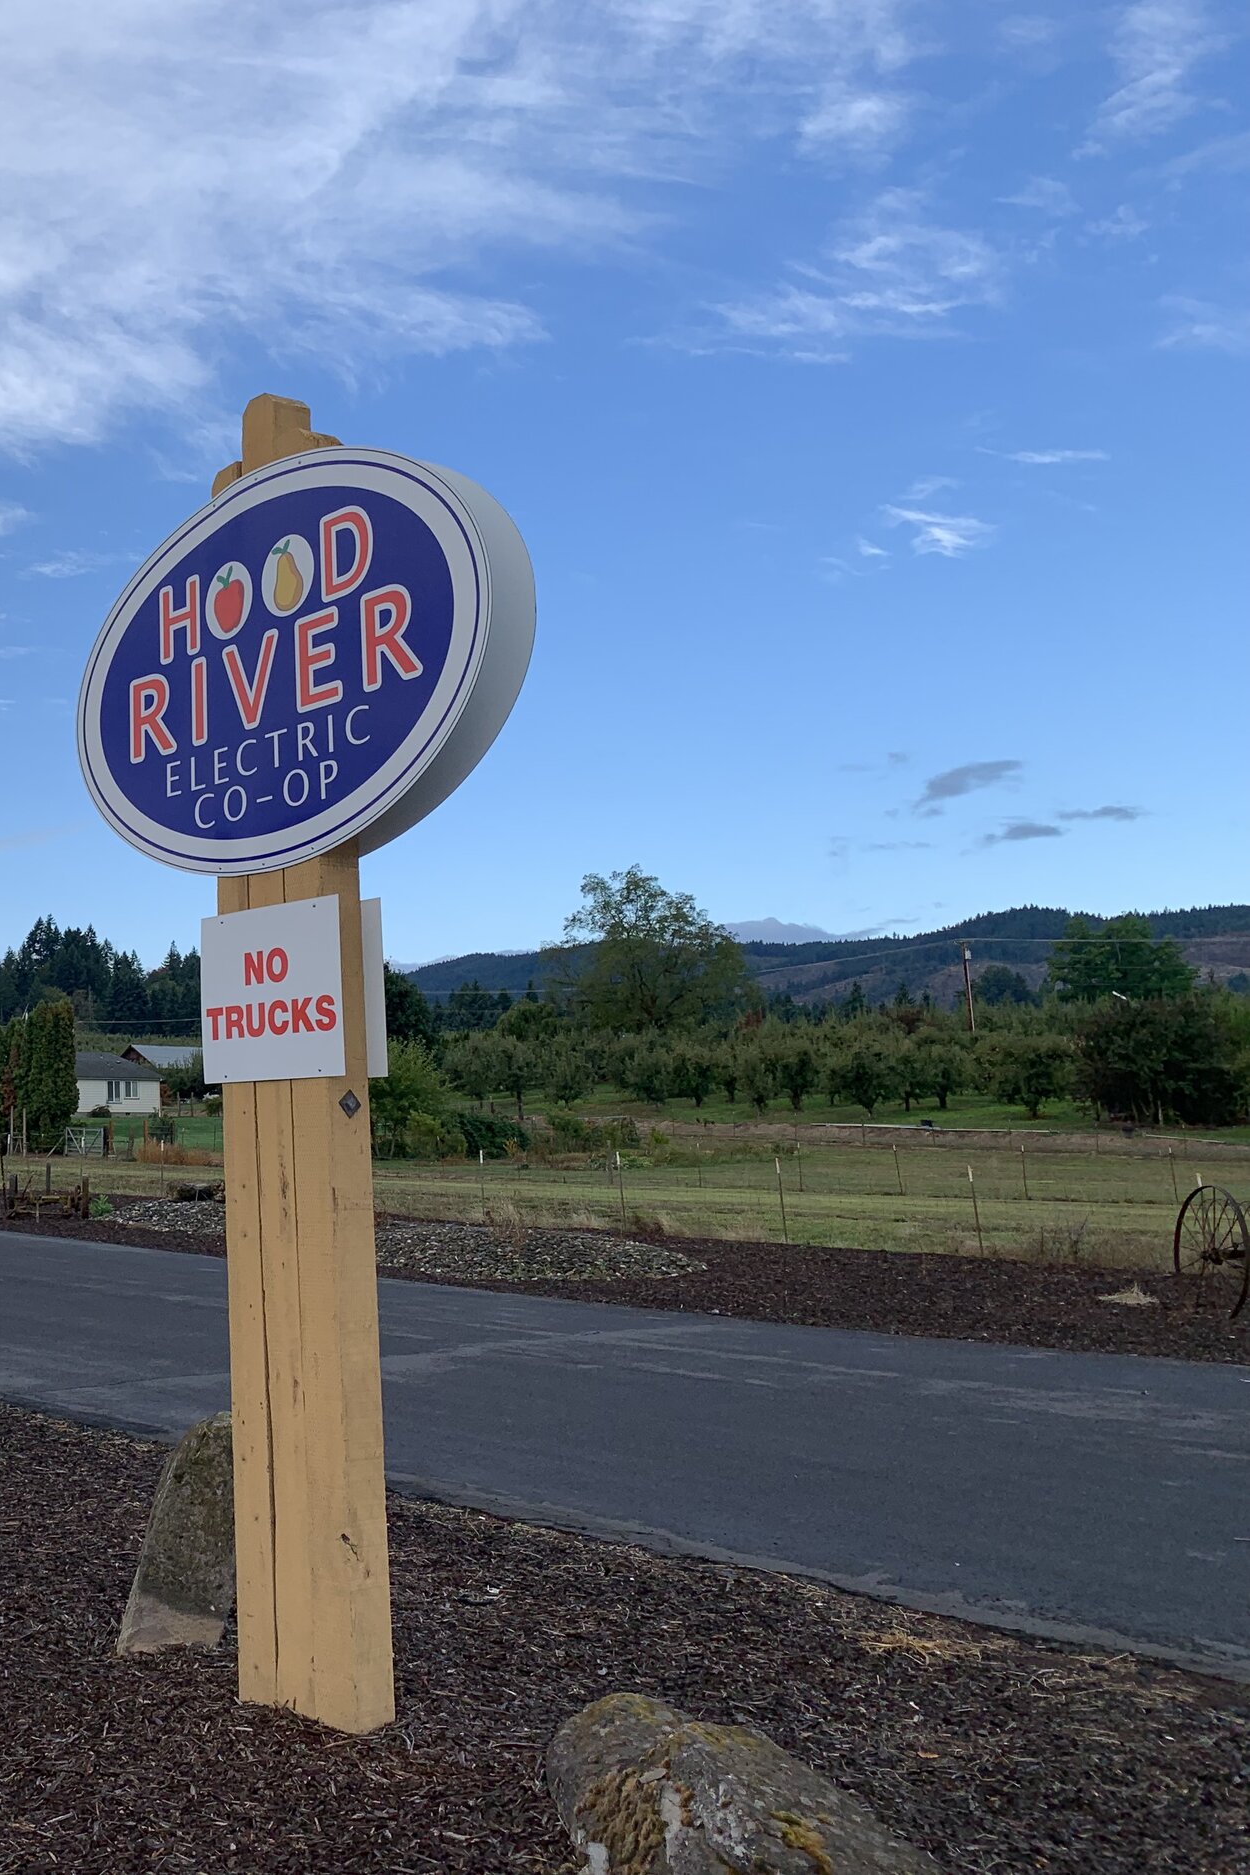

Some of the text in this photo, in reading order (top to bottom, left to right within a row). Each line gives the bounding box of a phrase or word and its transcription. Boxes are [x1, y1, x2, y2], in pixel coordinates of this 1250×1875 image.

[130, 584, 423, 764] RIVER
[166, 705, 371, 798] ELECTRIC
[194, 760, 339, 829] CO-OP
[244, 947, 288, 986] NO
[206, 994, 337, 1041] TRUCKS
